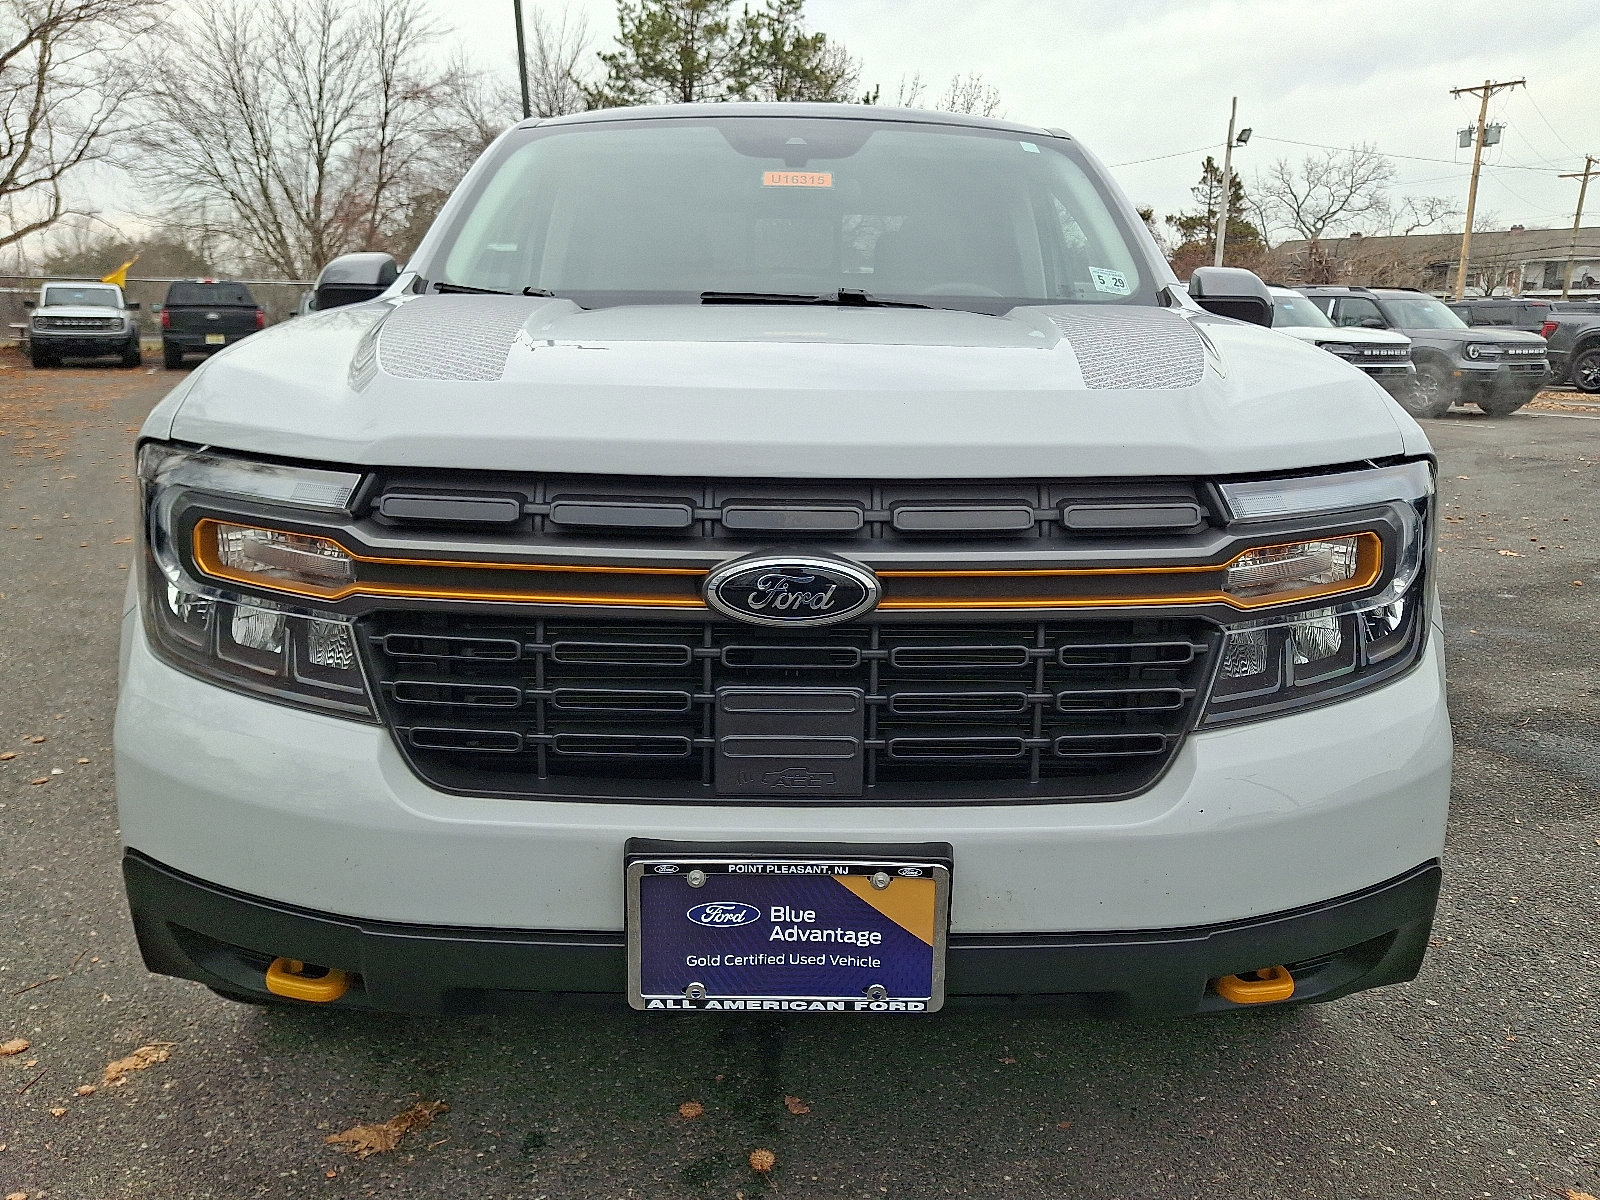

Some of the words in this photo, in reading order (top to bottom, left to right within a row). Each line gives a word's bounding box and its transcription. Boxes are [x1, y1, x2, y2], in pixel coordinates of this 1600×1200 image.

[771, 174, 825, 185] U16315
[1097, 274, 1106, 285] 5
[1111, 277, 1125, 288] 29
[747, 573, 837, 610] Ford
[728, 865, 764, 874] POINT
[766, 865, 832, 875] PLEASANT,
[834, 866, 849, 875] NJ
[700, 905, 746, 924] Ford
[770, 906, 816, 923] Blue
[769, 925, 882, 947] Advantage
[686, 954, 721, 967] Gold
[724, 954, 785, 967] Certified
[789, 954, 826, 967] Used
[829, 954, 881, 968] Vehicle
[647, 999, 697, 1009] ALL
[705, 1000, 849, 1011] AMERICAN
[854, 1001, 925, 1011] FORD
